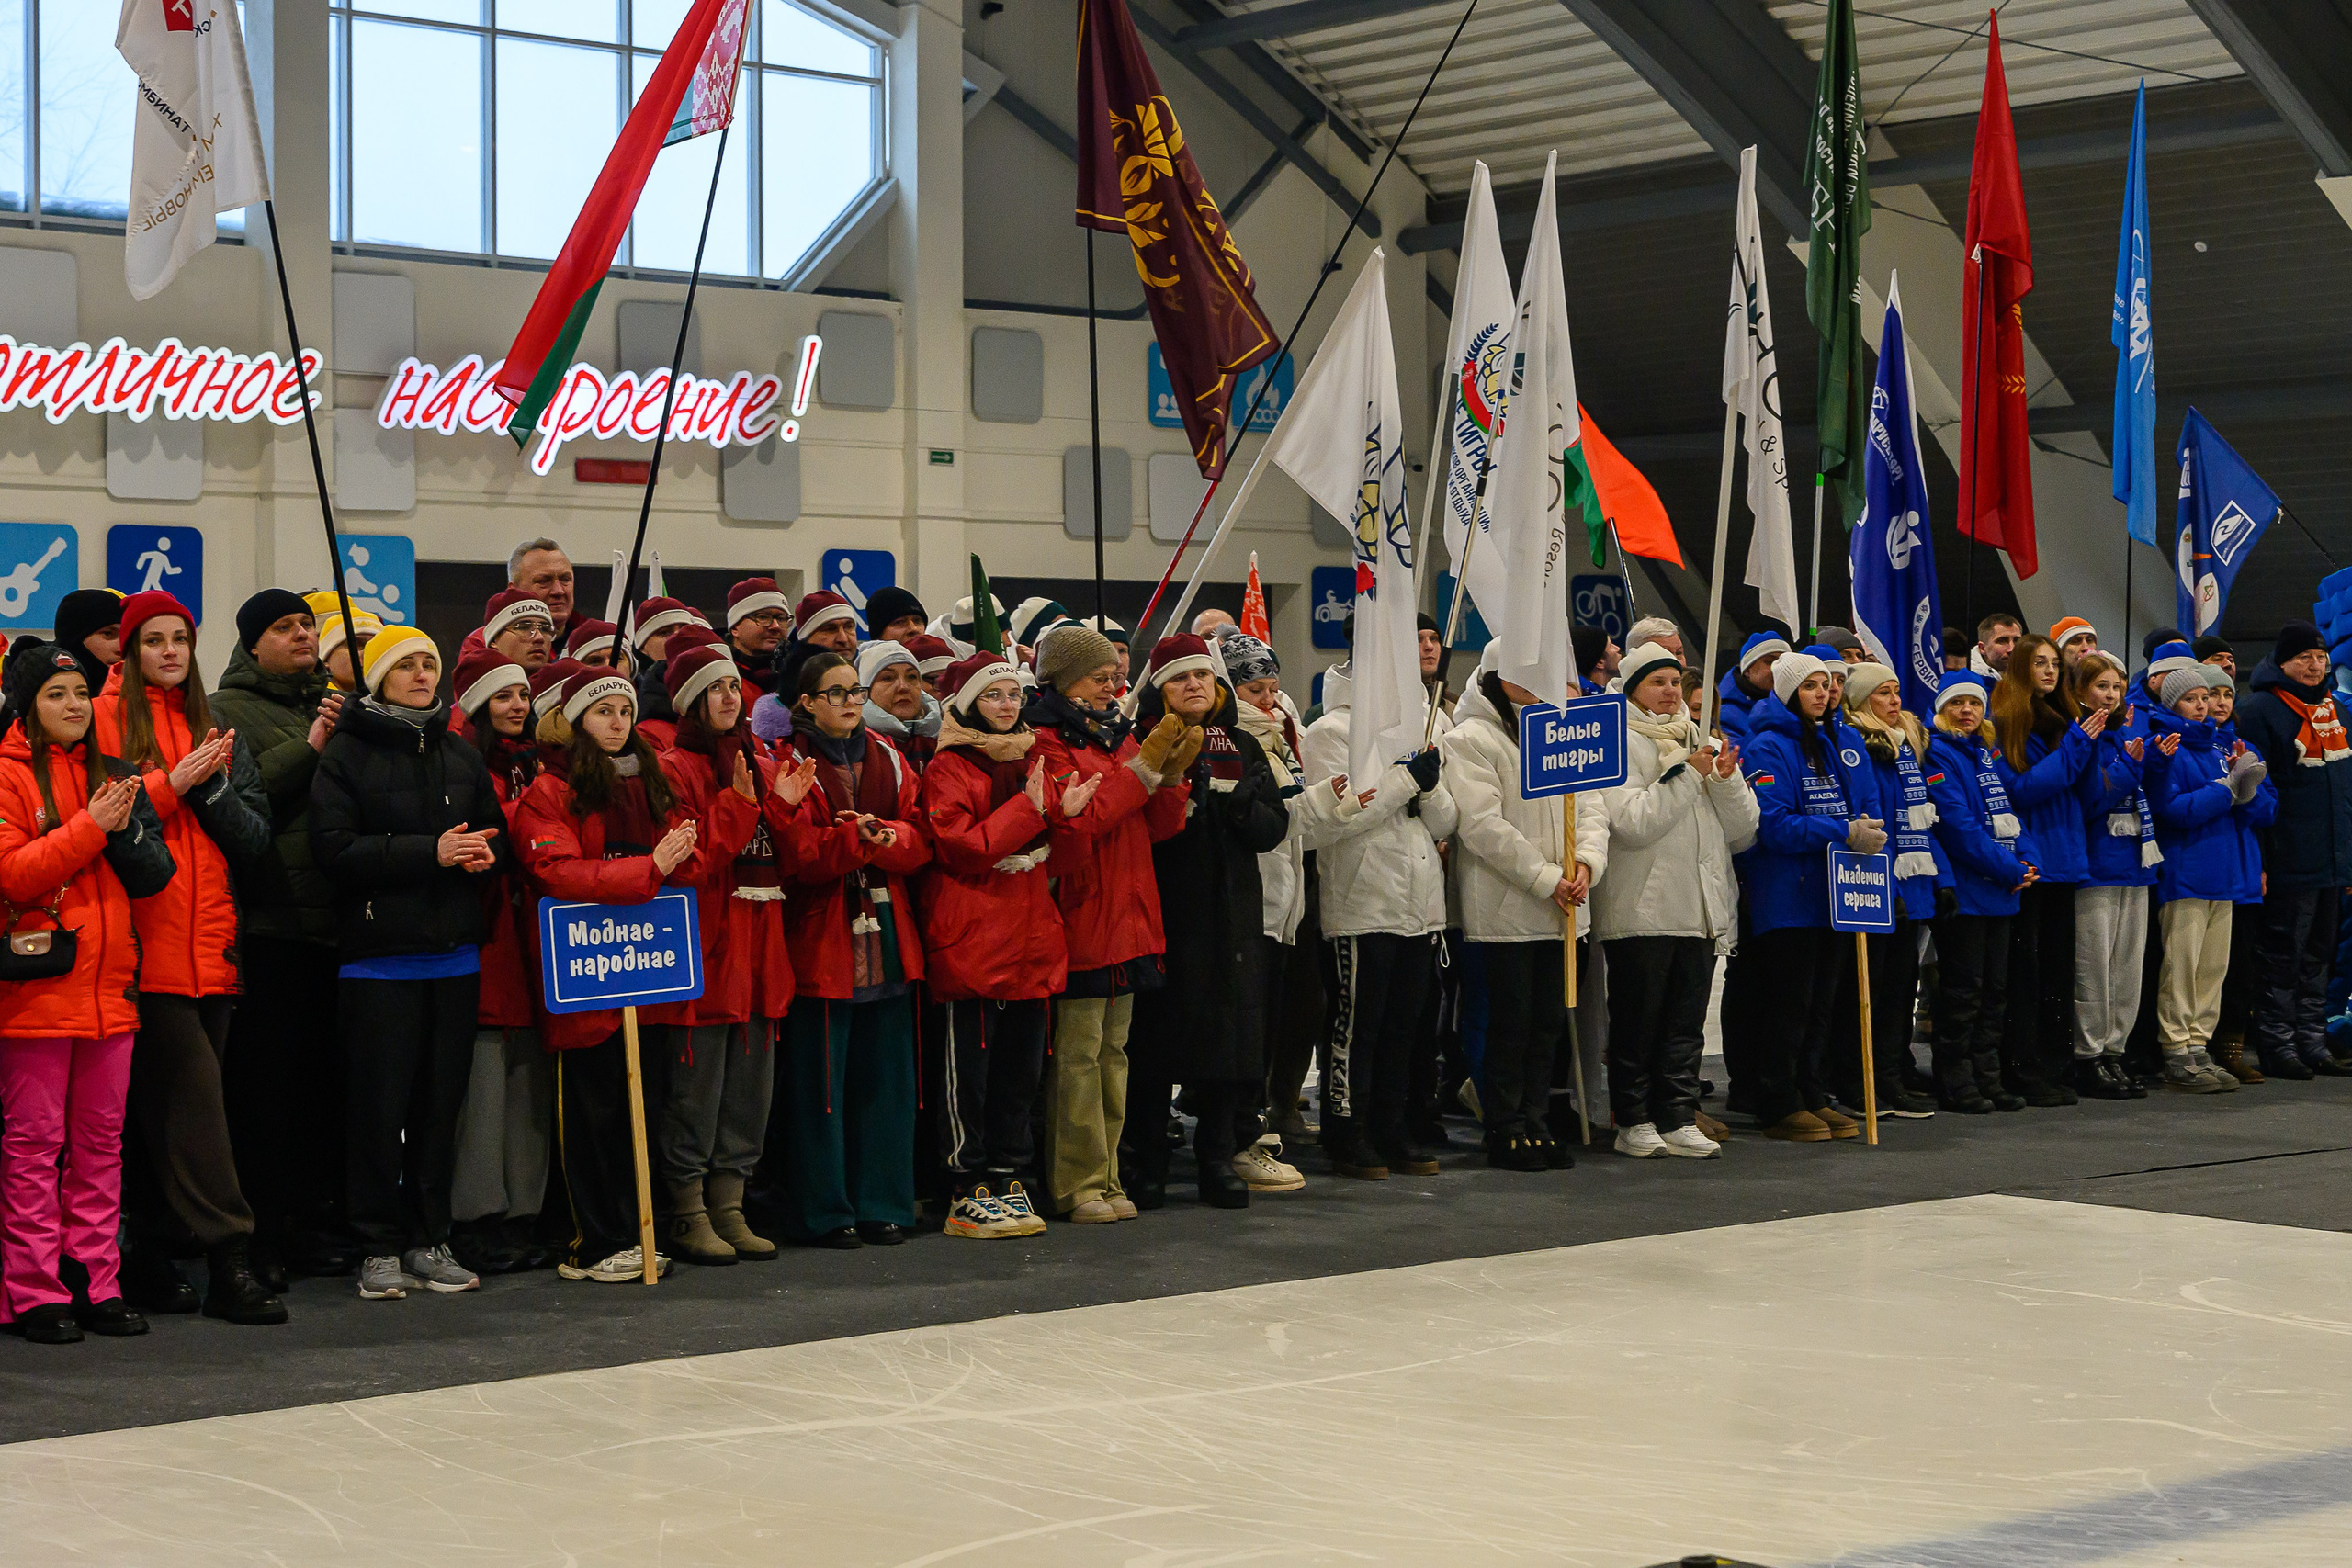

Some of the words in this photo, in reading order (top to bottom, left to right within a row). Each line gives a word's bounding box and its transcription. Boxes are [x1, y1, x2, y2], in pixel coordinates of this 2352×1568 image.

[1455, 467, 1491, 534] ОРГАНИЦИИ
[1545, 720, 1601, 745] Белые
[1542, 747, 1604, 773] тигры
[1838, 863, 1885, 886] Академия
[1843, 891, 1882, 912] сервиса
[568, 918, 655, 947] Моднае
[570, 945, 676, 982] народнае
